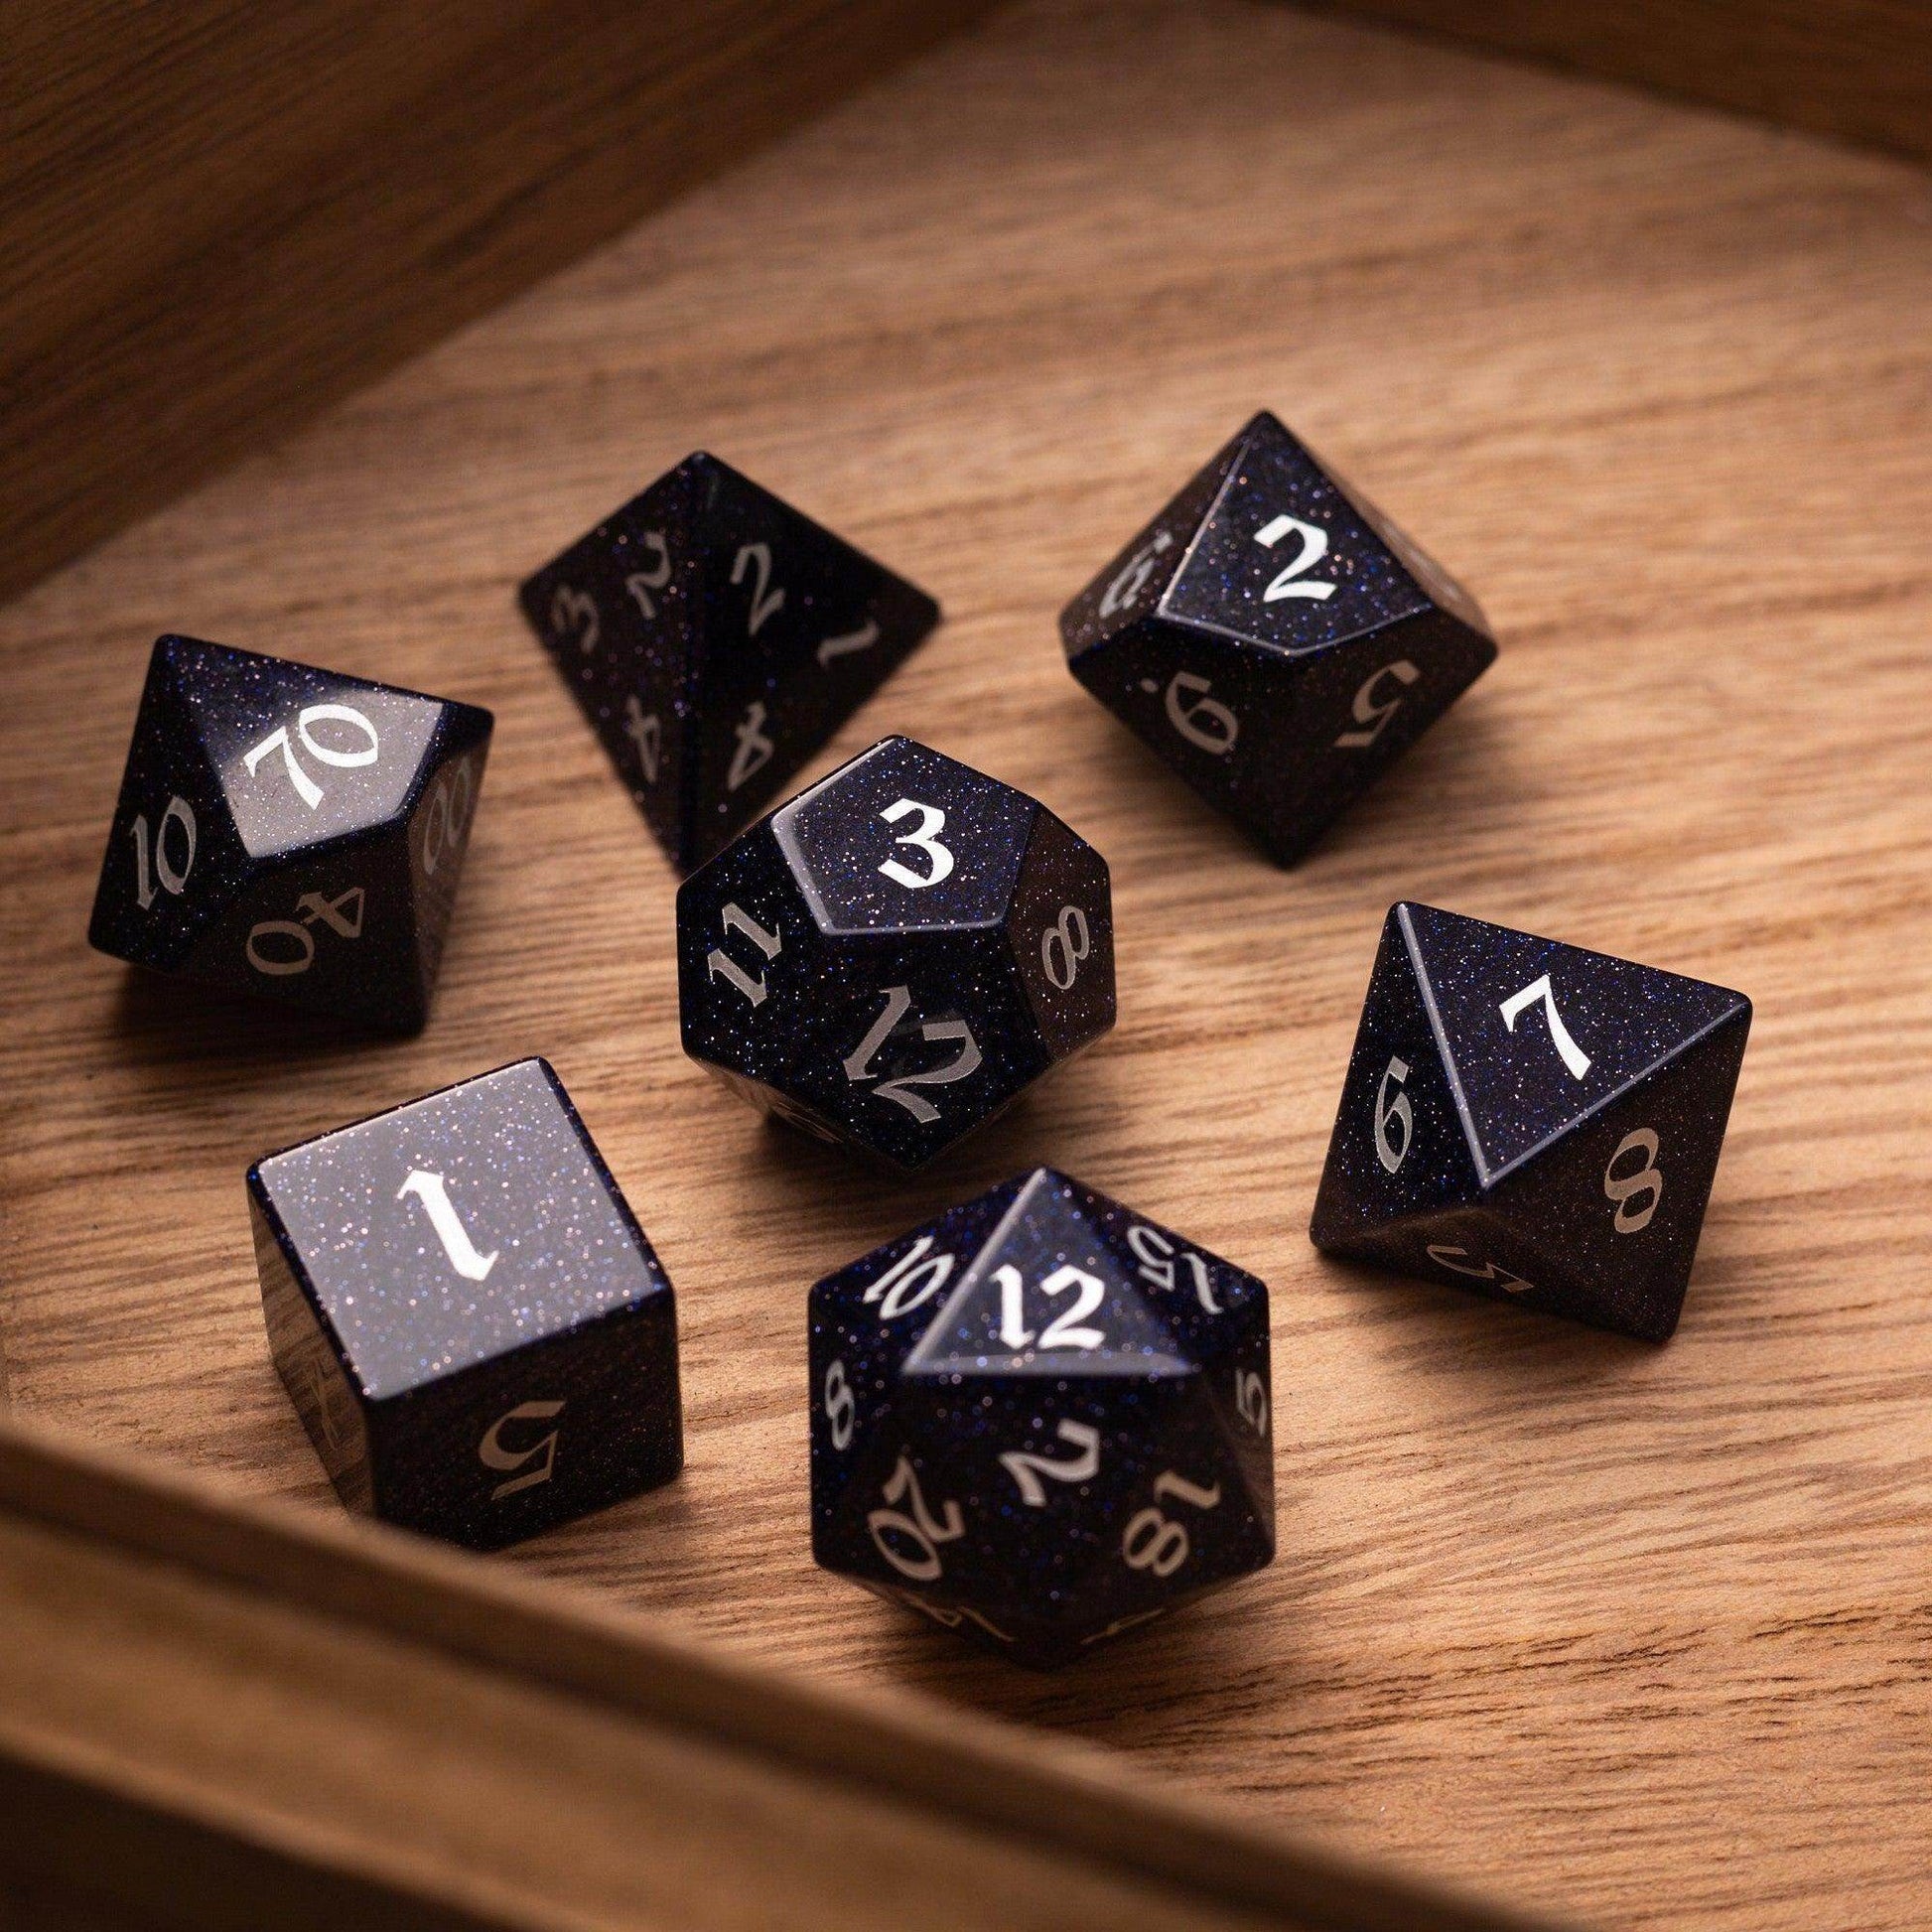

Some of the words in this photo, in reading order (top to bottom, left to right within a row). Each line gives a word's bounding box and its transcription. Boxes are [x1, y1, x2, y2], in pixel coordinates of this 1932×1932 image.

[626, 531, 673, 620] 2
[730, 542, 786, 636] 2
[1253, 514, 1337, 603] 2
[550, 585, 601, 653] 3
[817, 617, 881, 667] 1
[626, 694, 661, 783] 4
[728, 701, 775, 791] 4
[1333, 660, 1421, 748] 5
[243, 704, 378, 810] 70
[129, 795, 197, 910] 10
[878, 798, 954, 889] 3
[246, 887, 365, 976] 40
[707, 901, 782, 1008] 11
[1041, 905, 1090, 990] 8
[842, 985, 983, 1124] 12
[1499, 974, 1591, 1080] 7
[1374, 1054, 1413, 1173] 6
[397, 1170, 498, 1281] 1
[1604, 1127, 1663, 1234] 8
[862, 1235, 956, 1320] 10
[990, 1263, 1106, 1351] 12
[1126, 1225, 1224, 1315] 15
[478, 1400, 566, 1501] 5
[824, 1359, 855, 1451] 8
[998, 1418, 1101, 1508] 2
[866, 1454, 966, 1582] 20
[1121, 1470, 1221, 1578] 18
